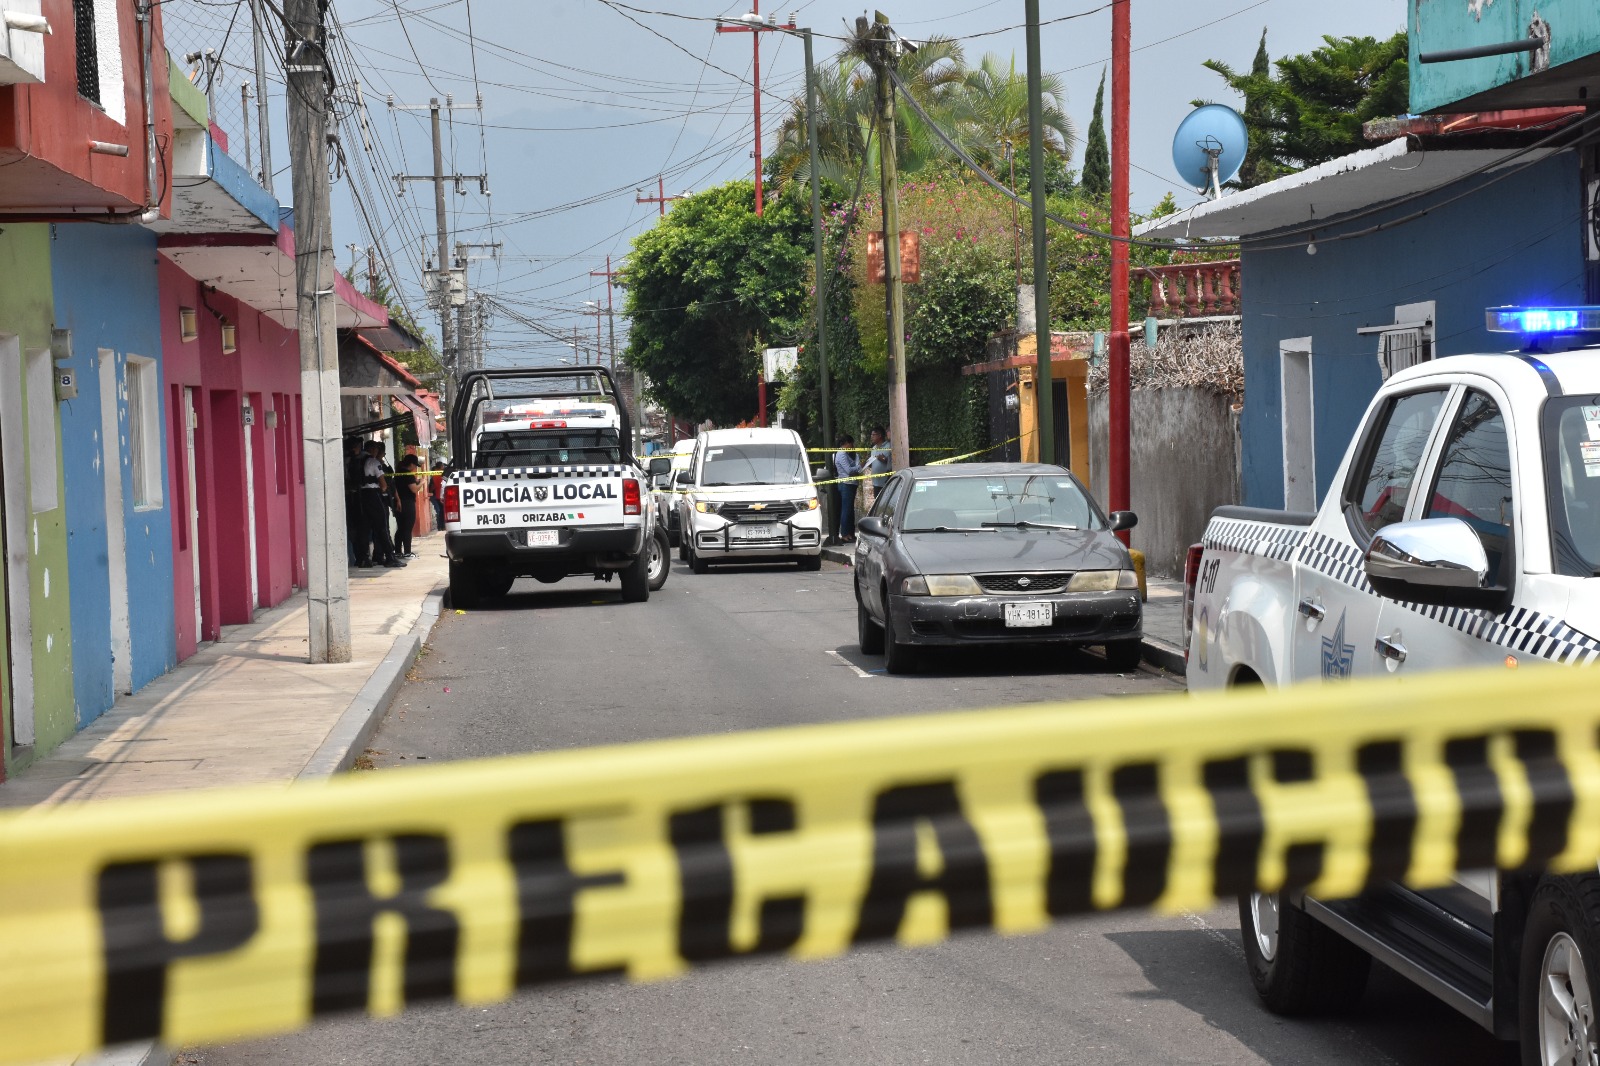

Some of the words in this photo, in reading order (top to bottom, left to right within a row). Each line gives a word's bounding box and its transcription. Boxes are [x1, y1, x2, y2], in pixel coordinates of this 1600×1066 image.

[62, 376, 71, 385] 8
[463, 483, 532, 505] POLICÍA
[553, 483, 617, 500] LOCAL
[477, 513, 506, 525] PA-03
[522, 513, 567, 523] ORIZABA
[96, 724, 1600, 1046] PRECAUCIO
